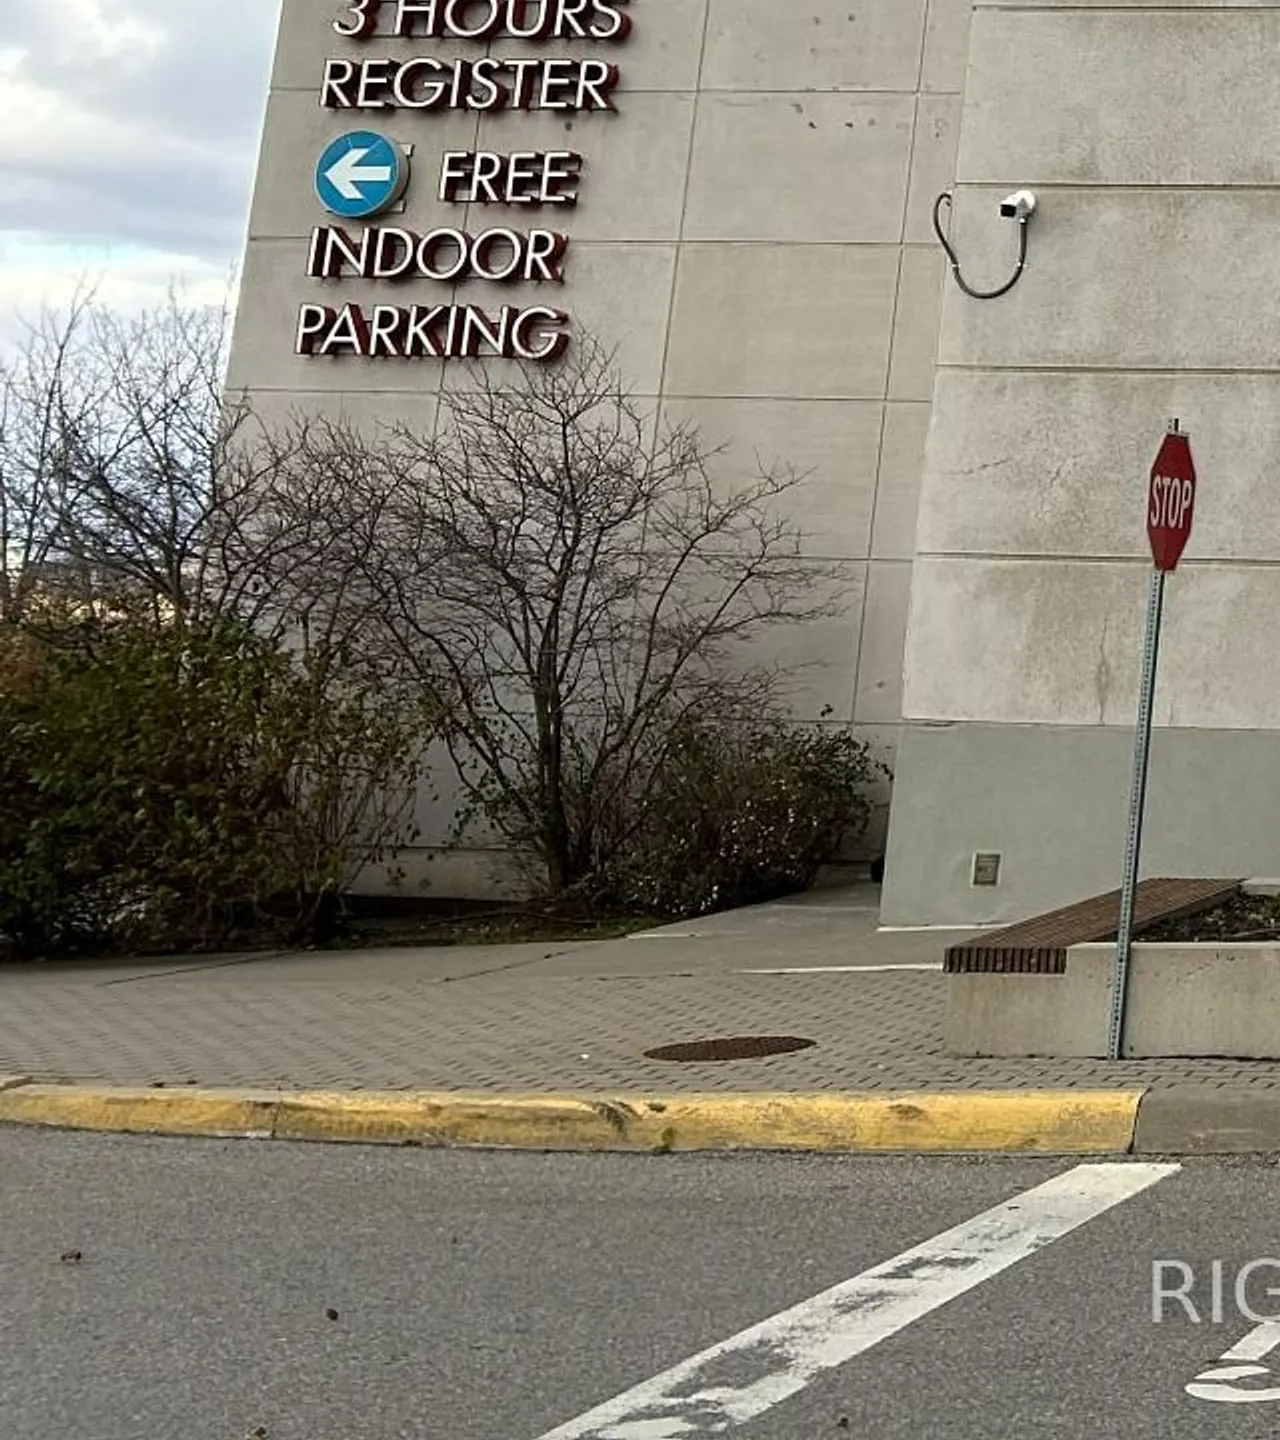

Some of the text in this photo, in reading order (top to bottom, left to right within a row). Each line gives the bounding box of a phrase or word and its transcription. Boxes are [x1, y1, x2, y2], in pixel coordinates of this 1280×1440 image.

[319, 57, 614, 111] REGISTER
[438, 151, 577, 205] FREE
[307, 226, 561, 281] INDOOR
[295, 303, 565, 360] PARKING
[1150, 475, 1193, 530] STOP
